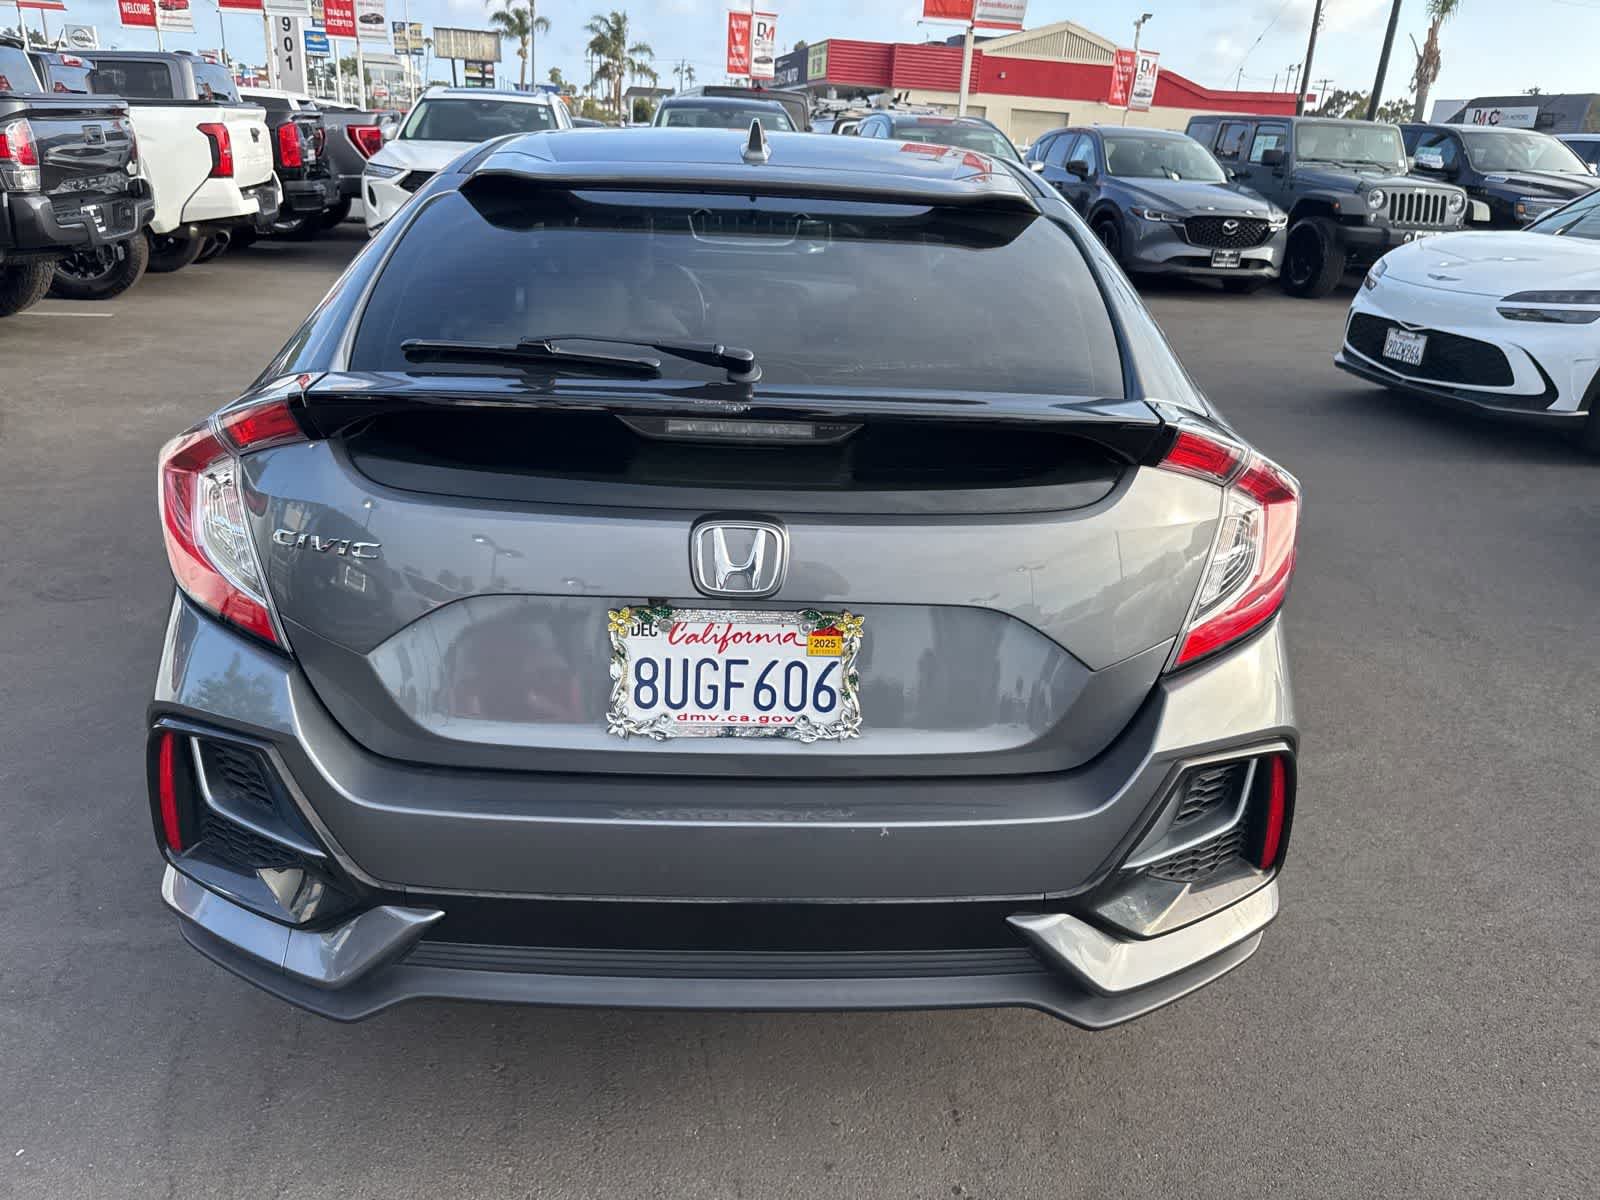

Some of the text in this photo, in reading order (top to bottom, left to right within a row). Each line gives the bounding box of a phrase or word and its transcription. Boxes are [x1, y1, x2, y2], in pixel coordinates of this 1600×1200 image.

[121, 2, 151, 16] WELCOME
[326, 19, 354, 28] ACCEPTED
[272, 528, 383, 559] CIVIC
[630, 621, 807, 655] DEC California
[813, 638, 837, 649] 2025
[633, 656, 840, 714] 8UGF606
[676, 712, 797, 725] dmv.ca.gov
